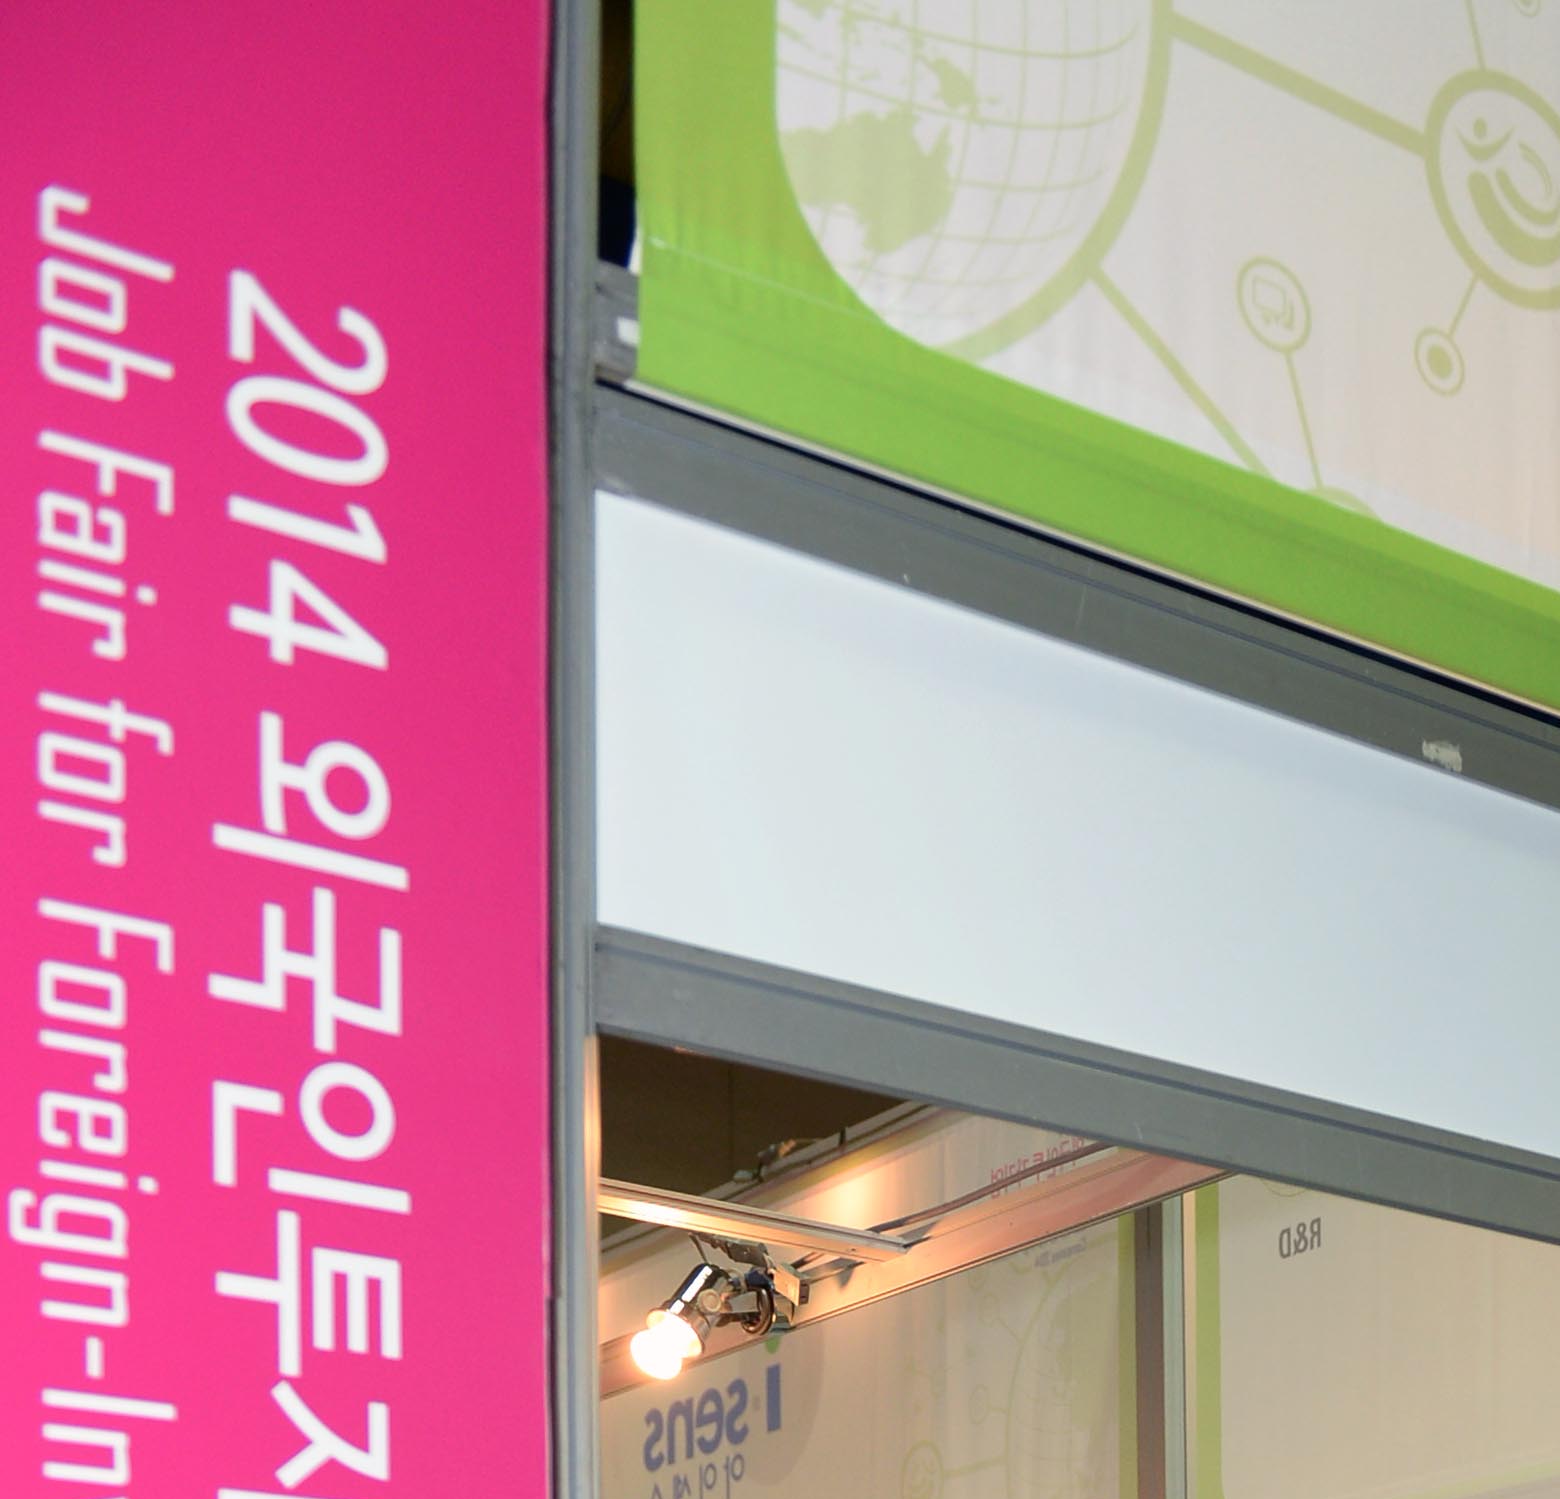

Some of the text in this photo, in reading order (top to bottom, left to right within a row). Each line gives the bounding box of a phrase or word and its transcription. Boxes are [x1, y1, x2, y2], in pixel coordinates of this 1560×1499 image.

[39, 187, 174, 400] Job
[38, 431, 174, 660] Fair
[226, 270, 388, 669] 2014
[38, 692, 173, 866] for
